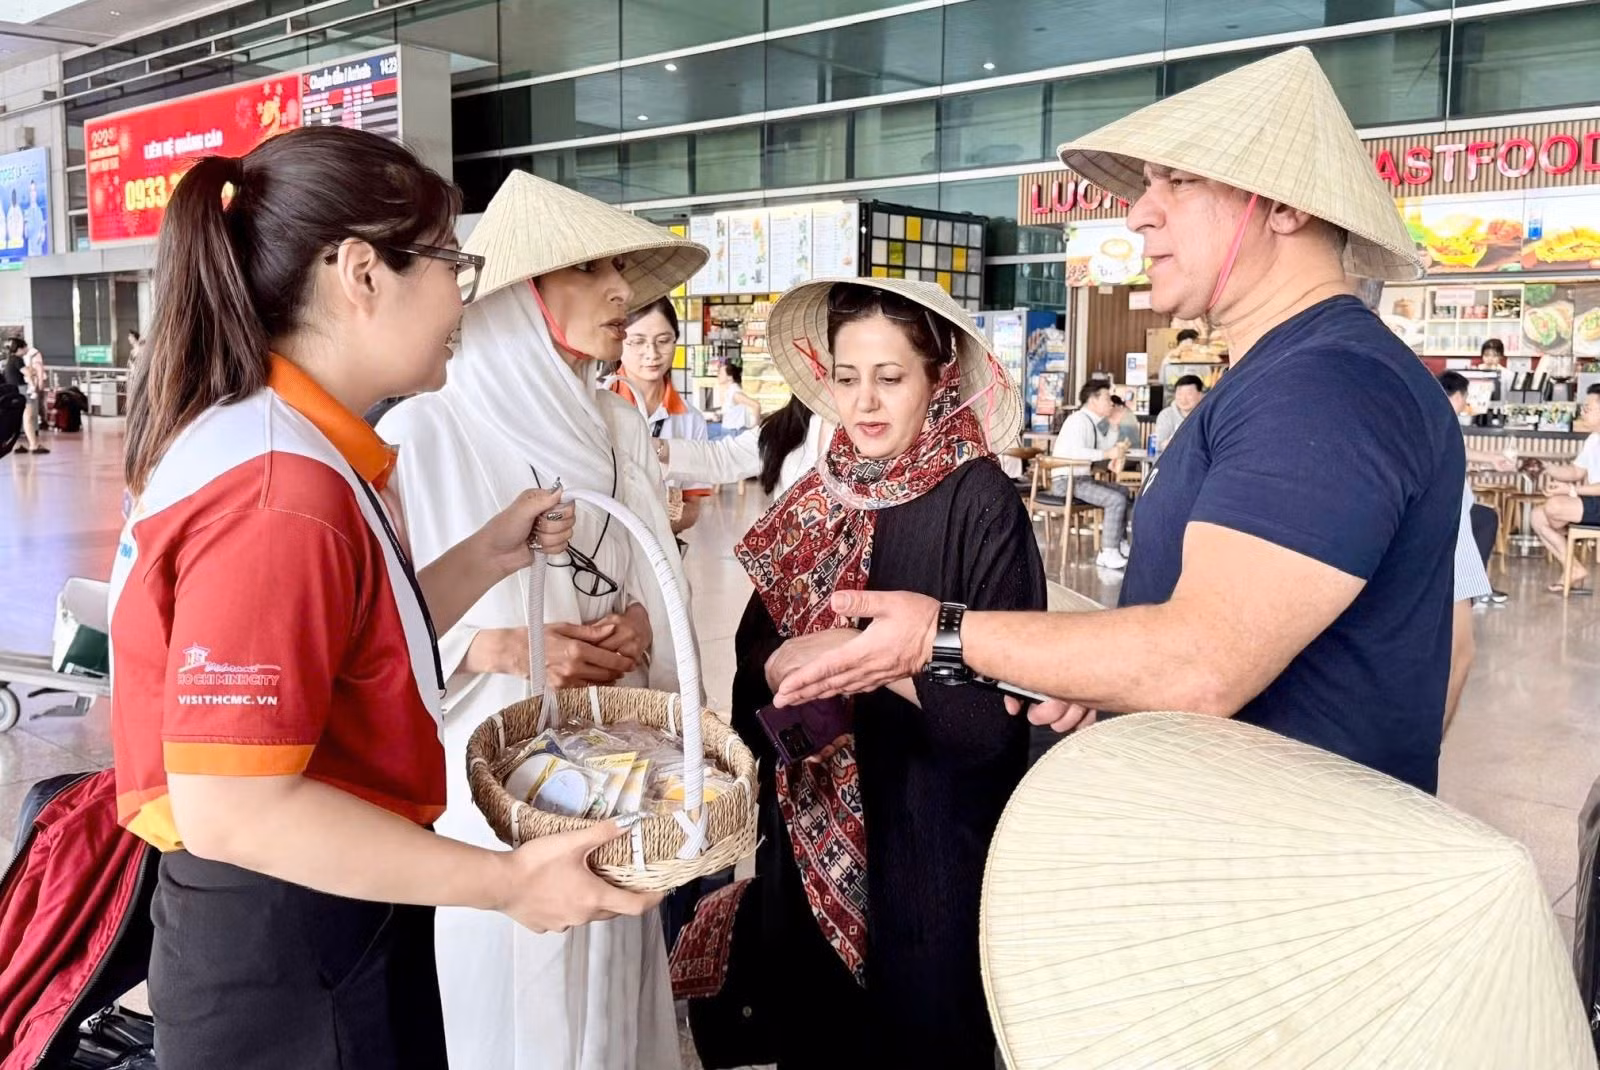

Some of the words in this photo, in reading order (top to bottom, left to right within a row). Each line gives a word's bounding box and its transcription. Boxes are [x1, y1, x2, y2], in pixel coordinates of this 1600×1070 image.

[1376, 131, 1600, 186] ASTFOOD
[125, 173, 180, 211] 0933
[178, 673, 193, 686] HO
[194, 673, 215, 686] CHI
[216, 673, 248, 686] MINH
[248, 673, 280, 686] CITY
[178, 695, 278, 706] VISITHCMC.VN
